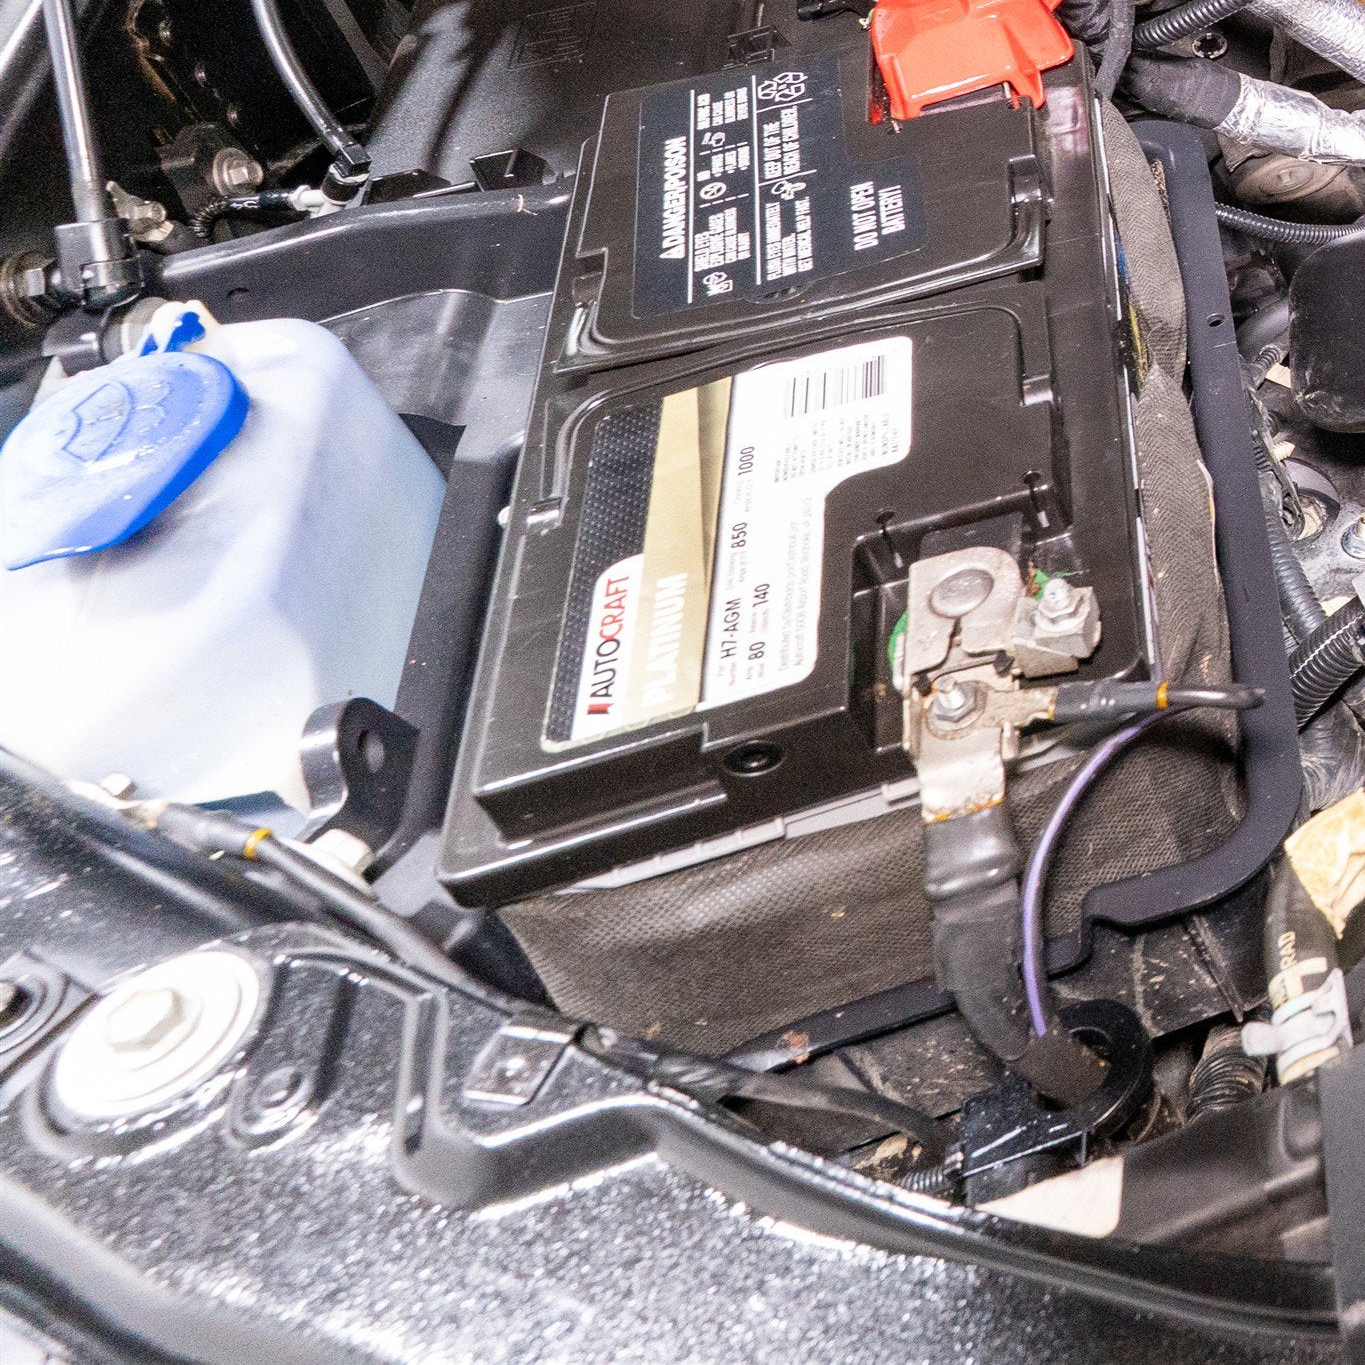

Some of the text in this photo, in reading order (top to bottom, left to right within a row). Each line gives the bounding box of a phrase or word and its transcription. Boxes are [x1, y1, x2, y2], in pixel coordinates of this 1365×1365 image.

[763, 121, 781, 179] KEEP OUT OF THE
[782, 141, 799, 152] OF
[783, 149, 800, 175] REACH
[661, 137, 687, 249] DANGER/POISON
[796, 215, 811, 232] HELP
[850, 181, 878, 250] DO NOT OPEN
[878, 185, 906, 235] BATTERY!
[765, 202, 782, 280] FLUSH EYES IMMEDIATELY
[797, 229, 812, 259] MEDICAL
[782, 255, 798, 276] WITH
[797, 256, 813, 272] GET
[737, 446, 755, 476] 1000
[730, 522, 748, 548] 850
[752, 584, 770, 608] 140
[586, 576, 629, 698] AUTOCRAFT
[642, 572, 688, 707] PLATINUM
[720, 598, 741, 659] H7-AGM
[748, 641, 766, 660] 80
[1278, 930, 1298, 971] RAD
